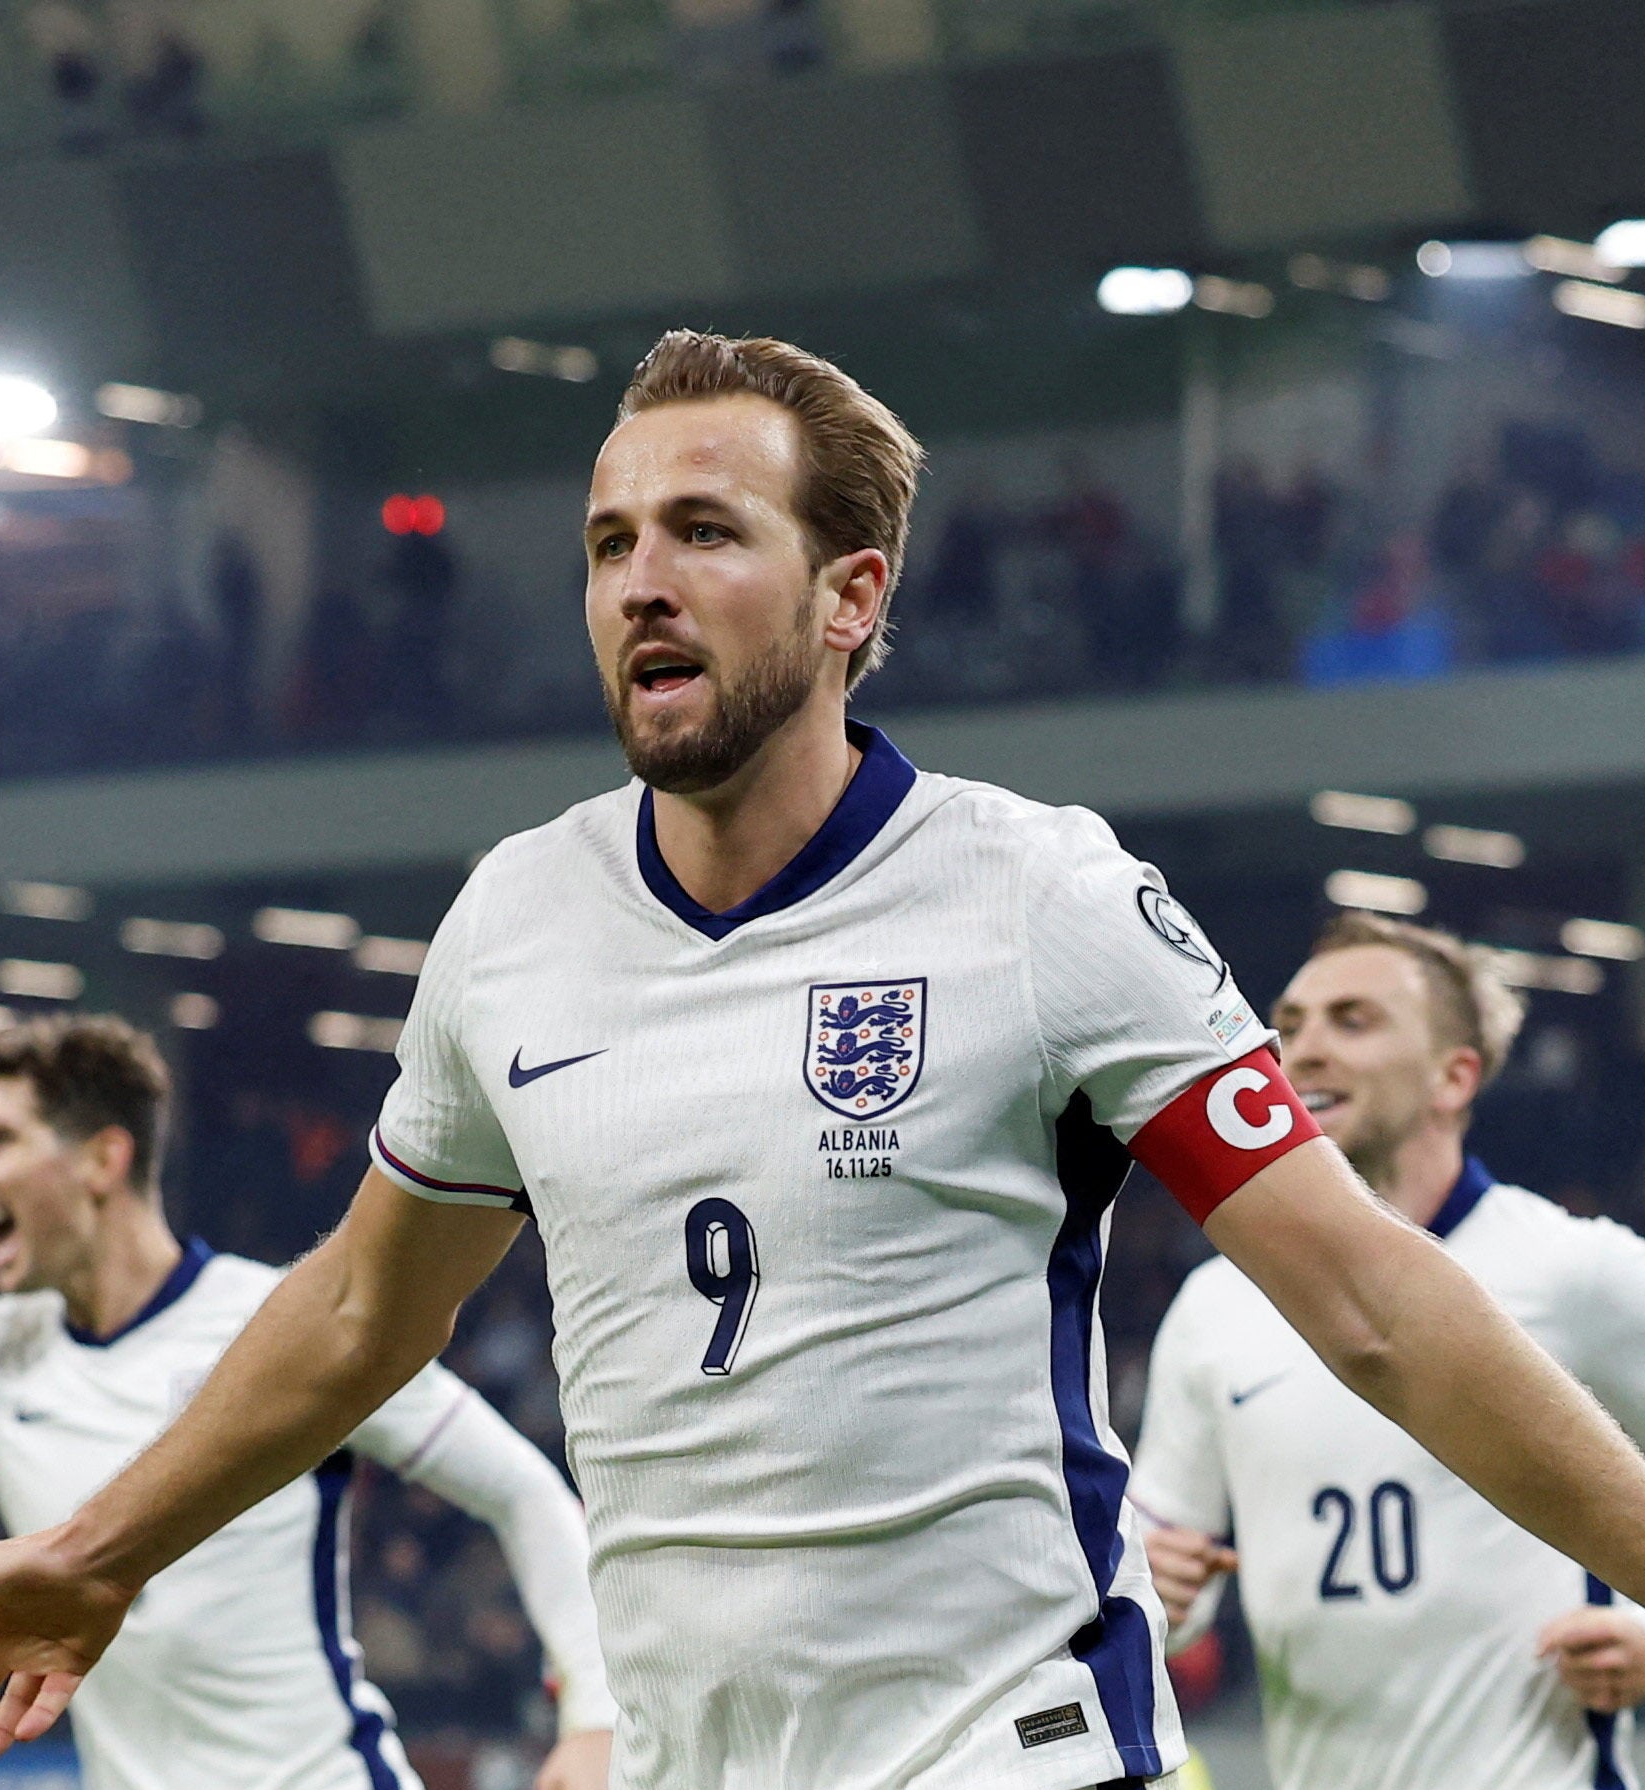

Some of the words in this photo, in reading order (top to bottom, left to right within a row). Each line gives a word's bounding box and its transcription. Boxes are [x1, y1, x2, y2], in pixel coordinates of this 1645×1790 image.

[818, 1129, 900, 1151] ALBANIA
[1206, 1067, 1293, 1150] C
[826, 1157, 892, 1179] 16.11.25
[685, 1197, 760, 1375] 9
[1313, 1483, 1418, 1602] 20
